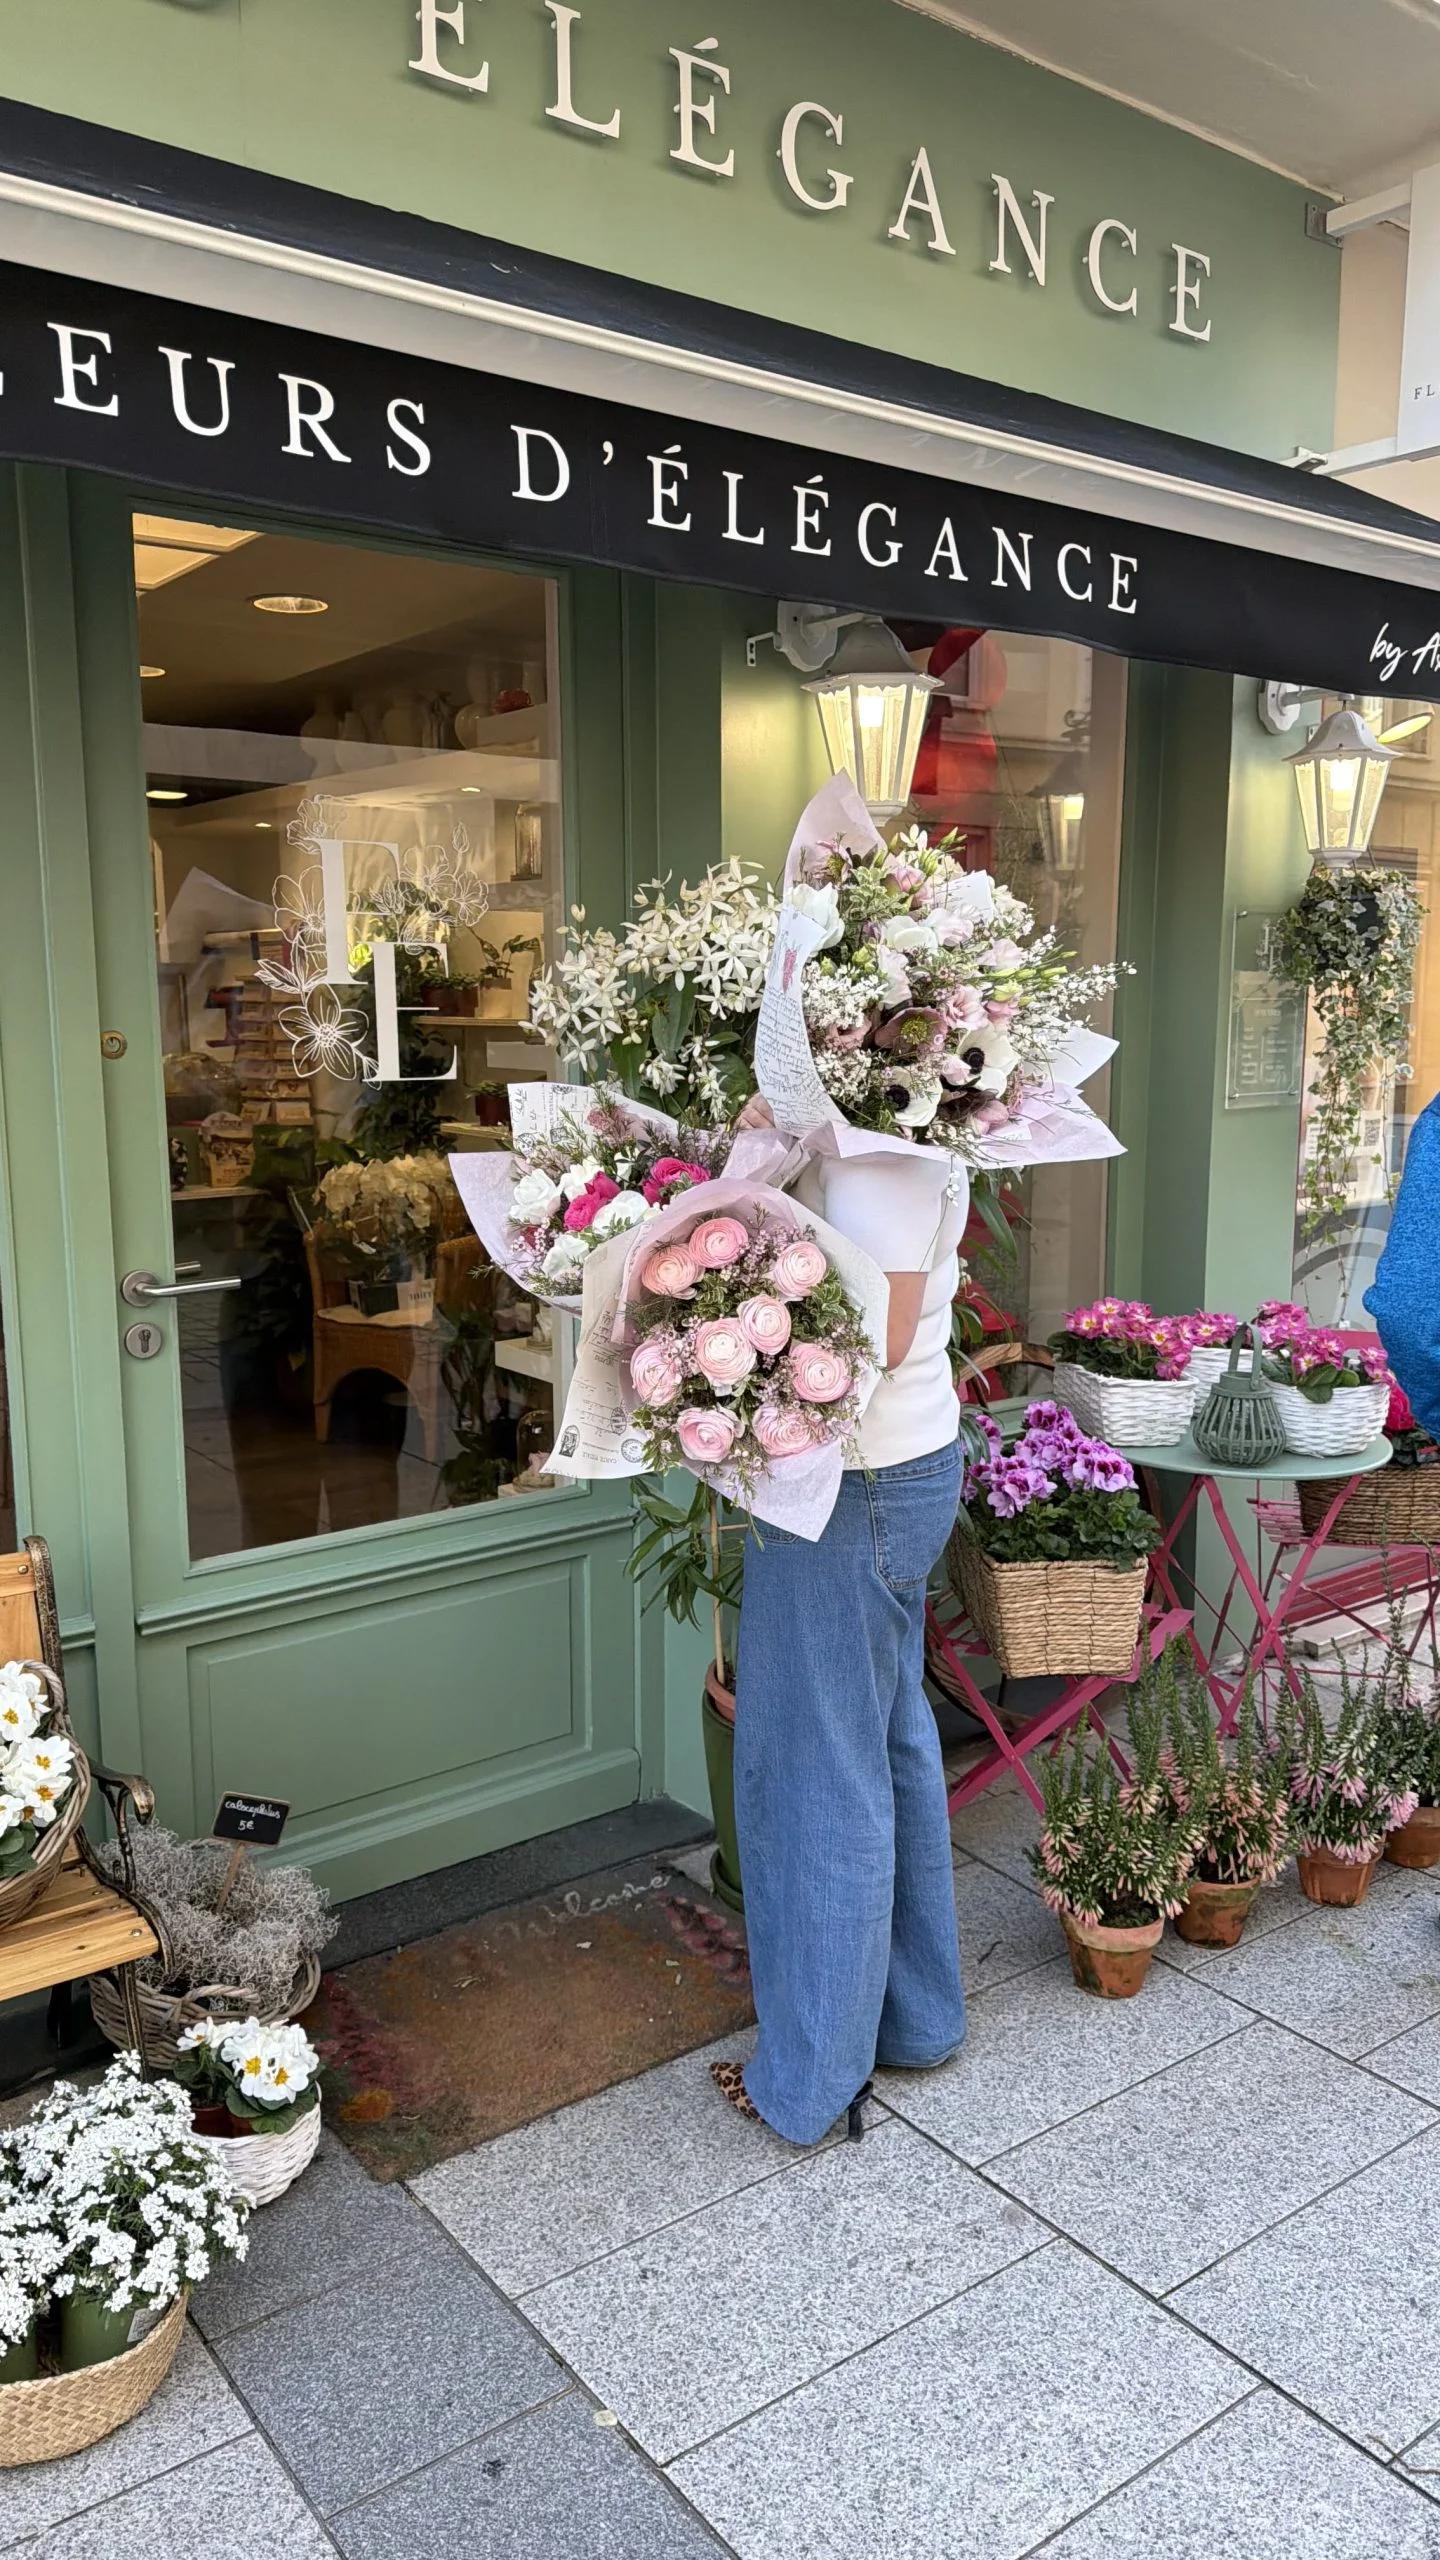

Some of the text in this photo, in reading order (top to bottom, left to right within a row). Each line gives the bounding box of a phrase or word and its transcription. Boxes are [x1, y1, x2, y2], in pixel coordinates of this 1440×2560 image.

[1413, 383, 1440, 400] FL
[0, 322, 1140, 614] EURS D'ÉLÉGANCE
[1369, 622, 1408, 682] by
[362, 941, 457, 1082] E
[238, 1820, 255, 1831] 5€
